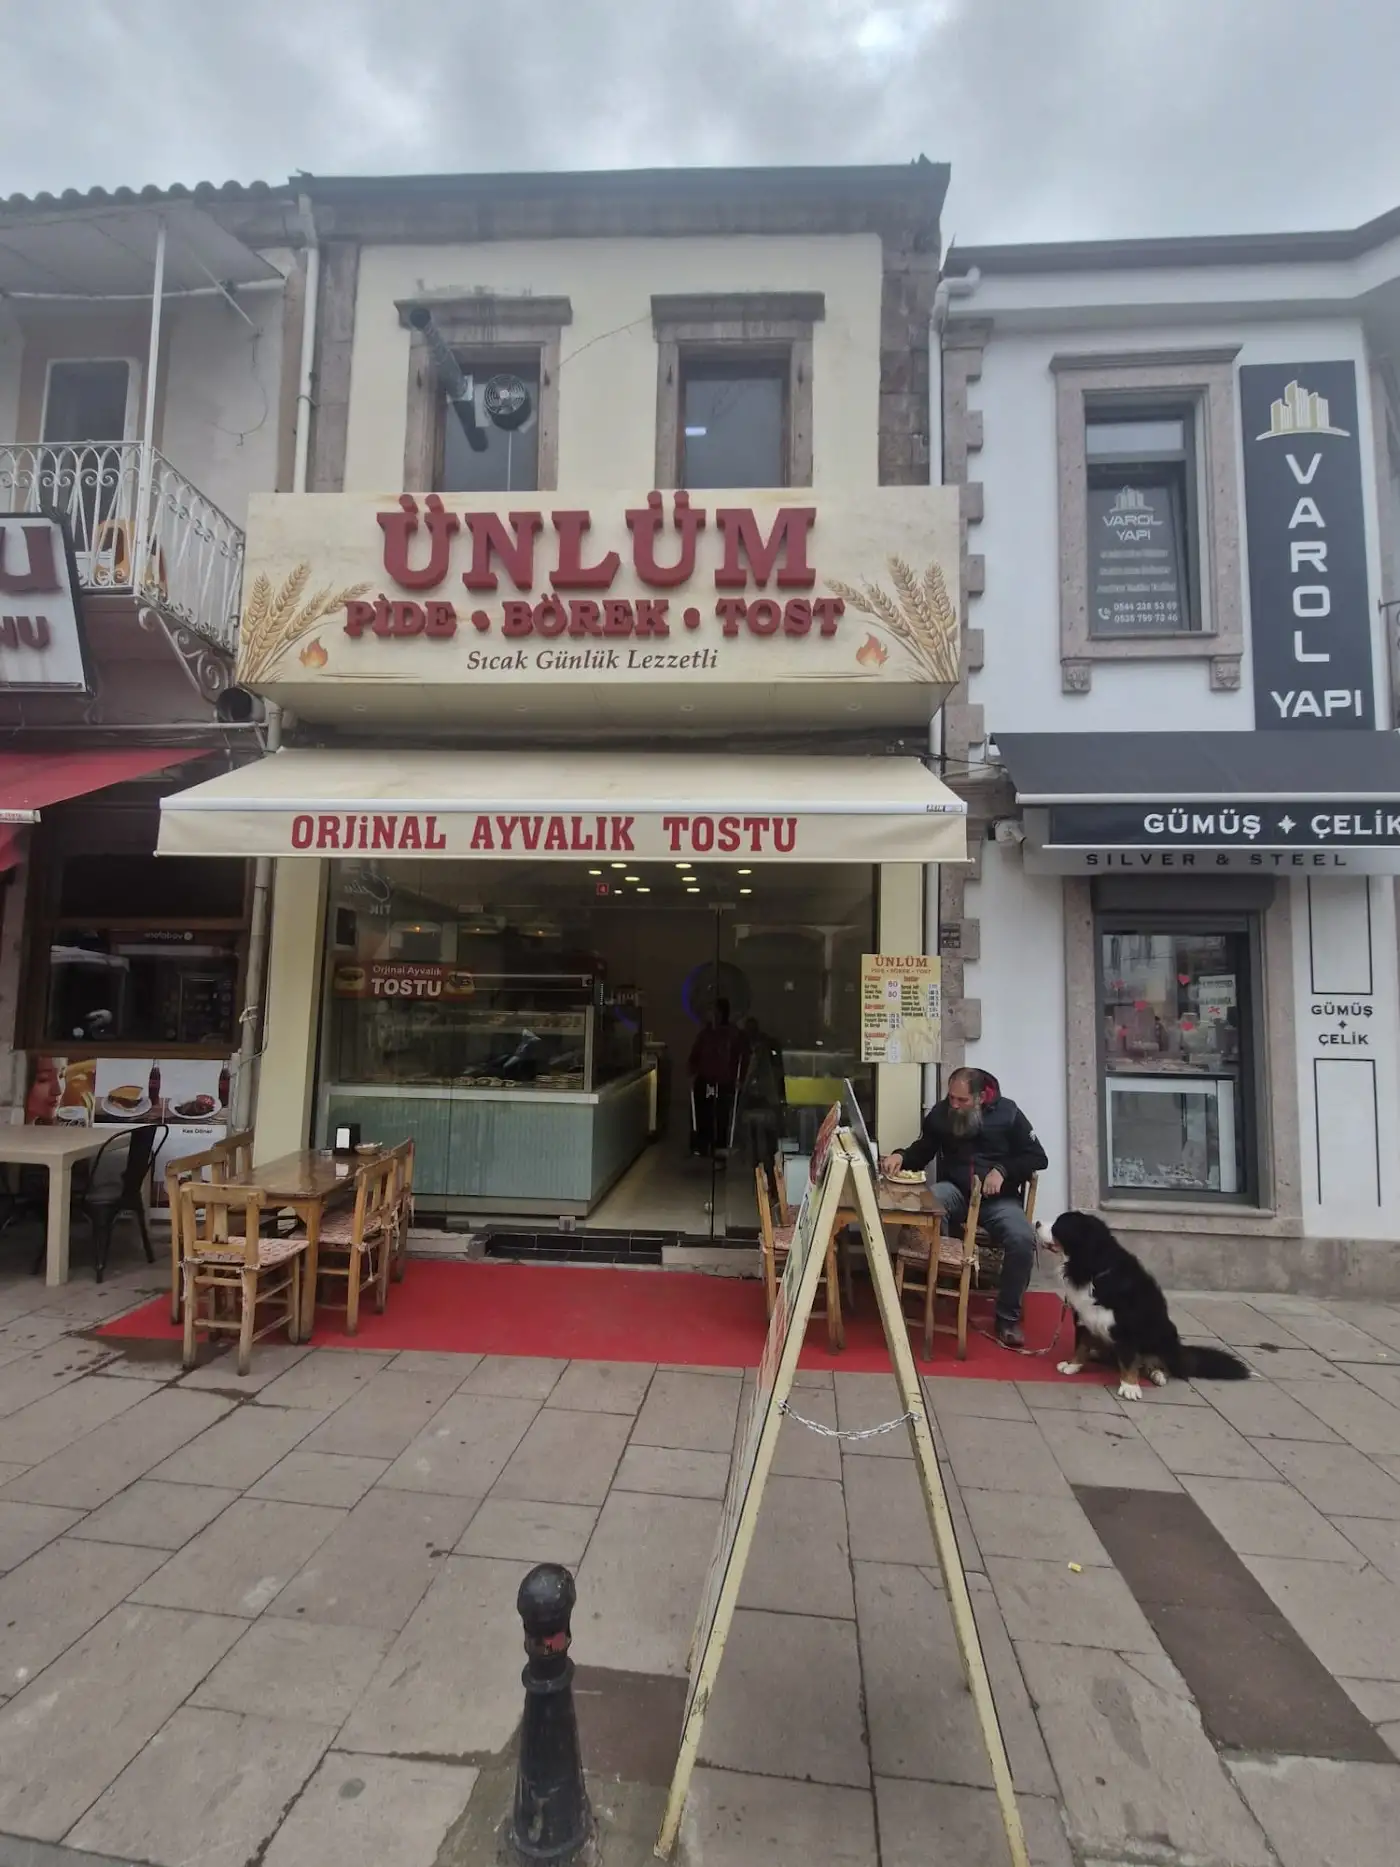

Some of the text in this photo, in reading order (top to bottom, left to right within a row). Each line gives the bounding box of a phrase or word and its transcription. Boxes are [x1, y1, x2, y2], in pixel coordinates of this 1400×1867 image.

[1102, 515, 1164, 527] VAROL
[376, 489, 817, 590] ÜNLÜM
[1116, 529, 1151, 541] YAPI
[1285, 453, 1330, 663] VAROL
[343, 593, 845, 639] PİDE BÖREK TOST
[466, 649, 718, 671] Sıcak Günlük Lezzetli
[1271, 690, 1362, 718] YAPI
[1143, 808, 1261, 840] GÜMÜŞ
[470, 816, 635, 852] AYVALIK
[663, 817, 798, 853] TOSTU
[1086, 853, 1347, 867] SILVER & STEEL
[875, 953, 928, 967] ÜNLÜM
[371, 977, 442, 996] TOSTU
[1311, 1001, 1374, 1019] GÜMÜŞ
[1318, 1030, 1369, 1048] ÇELİK
